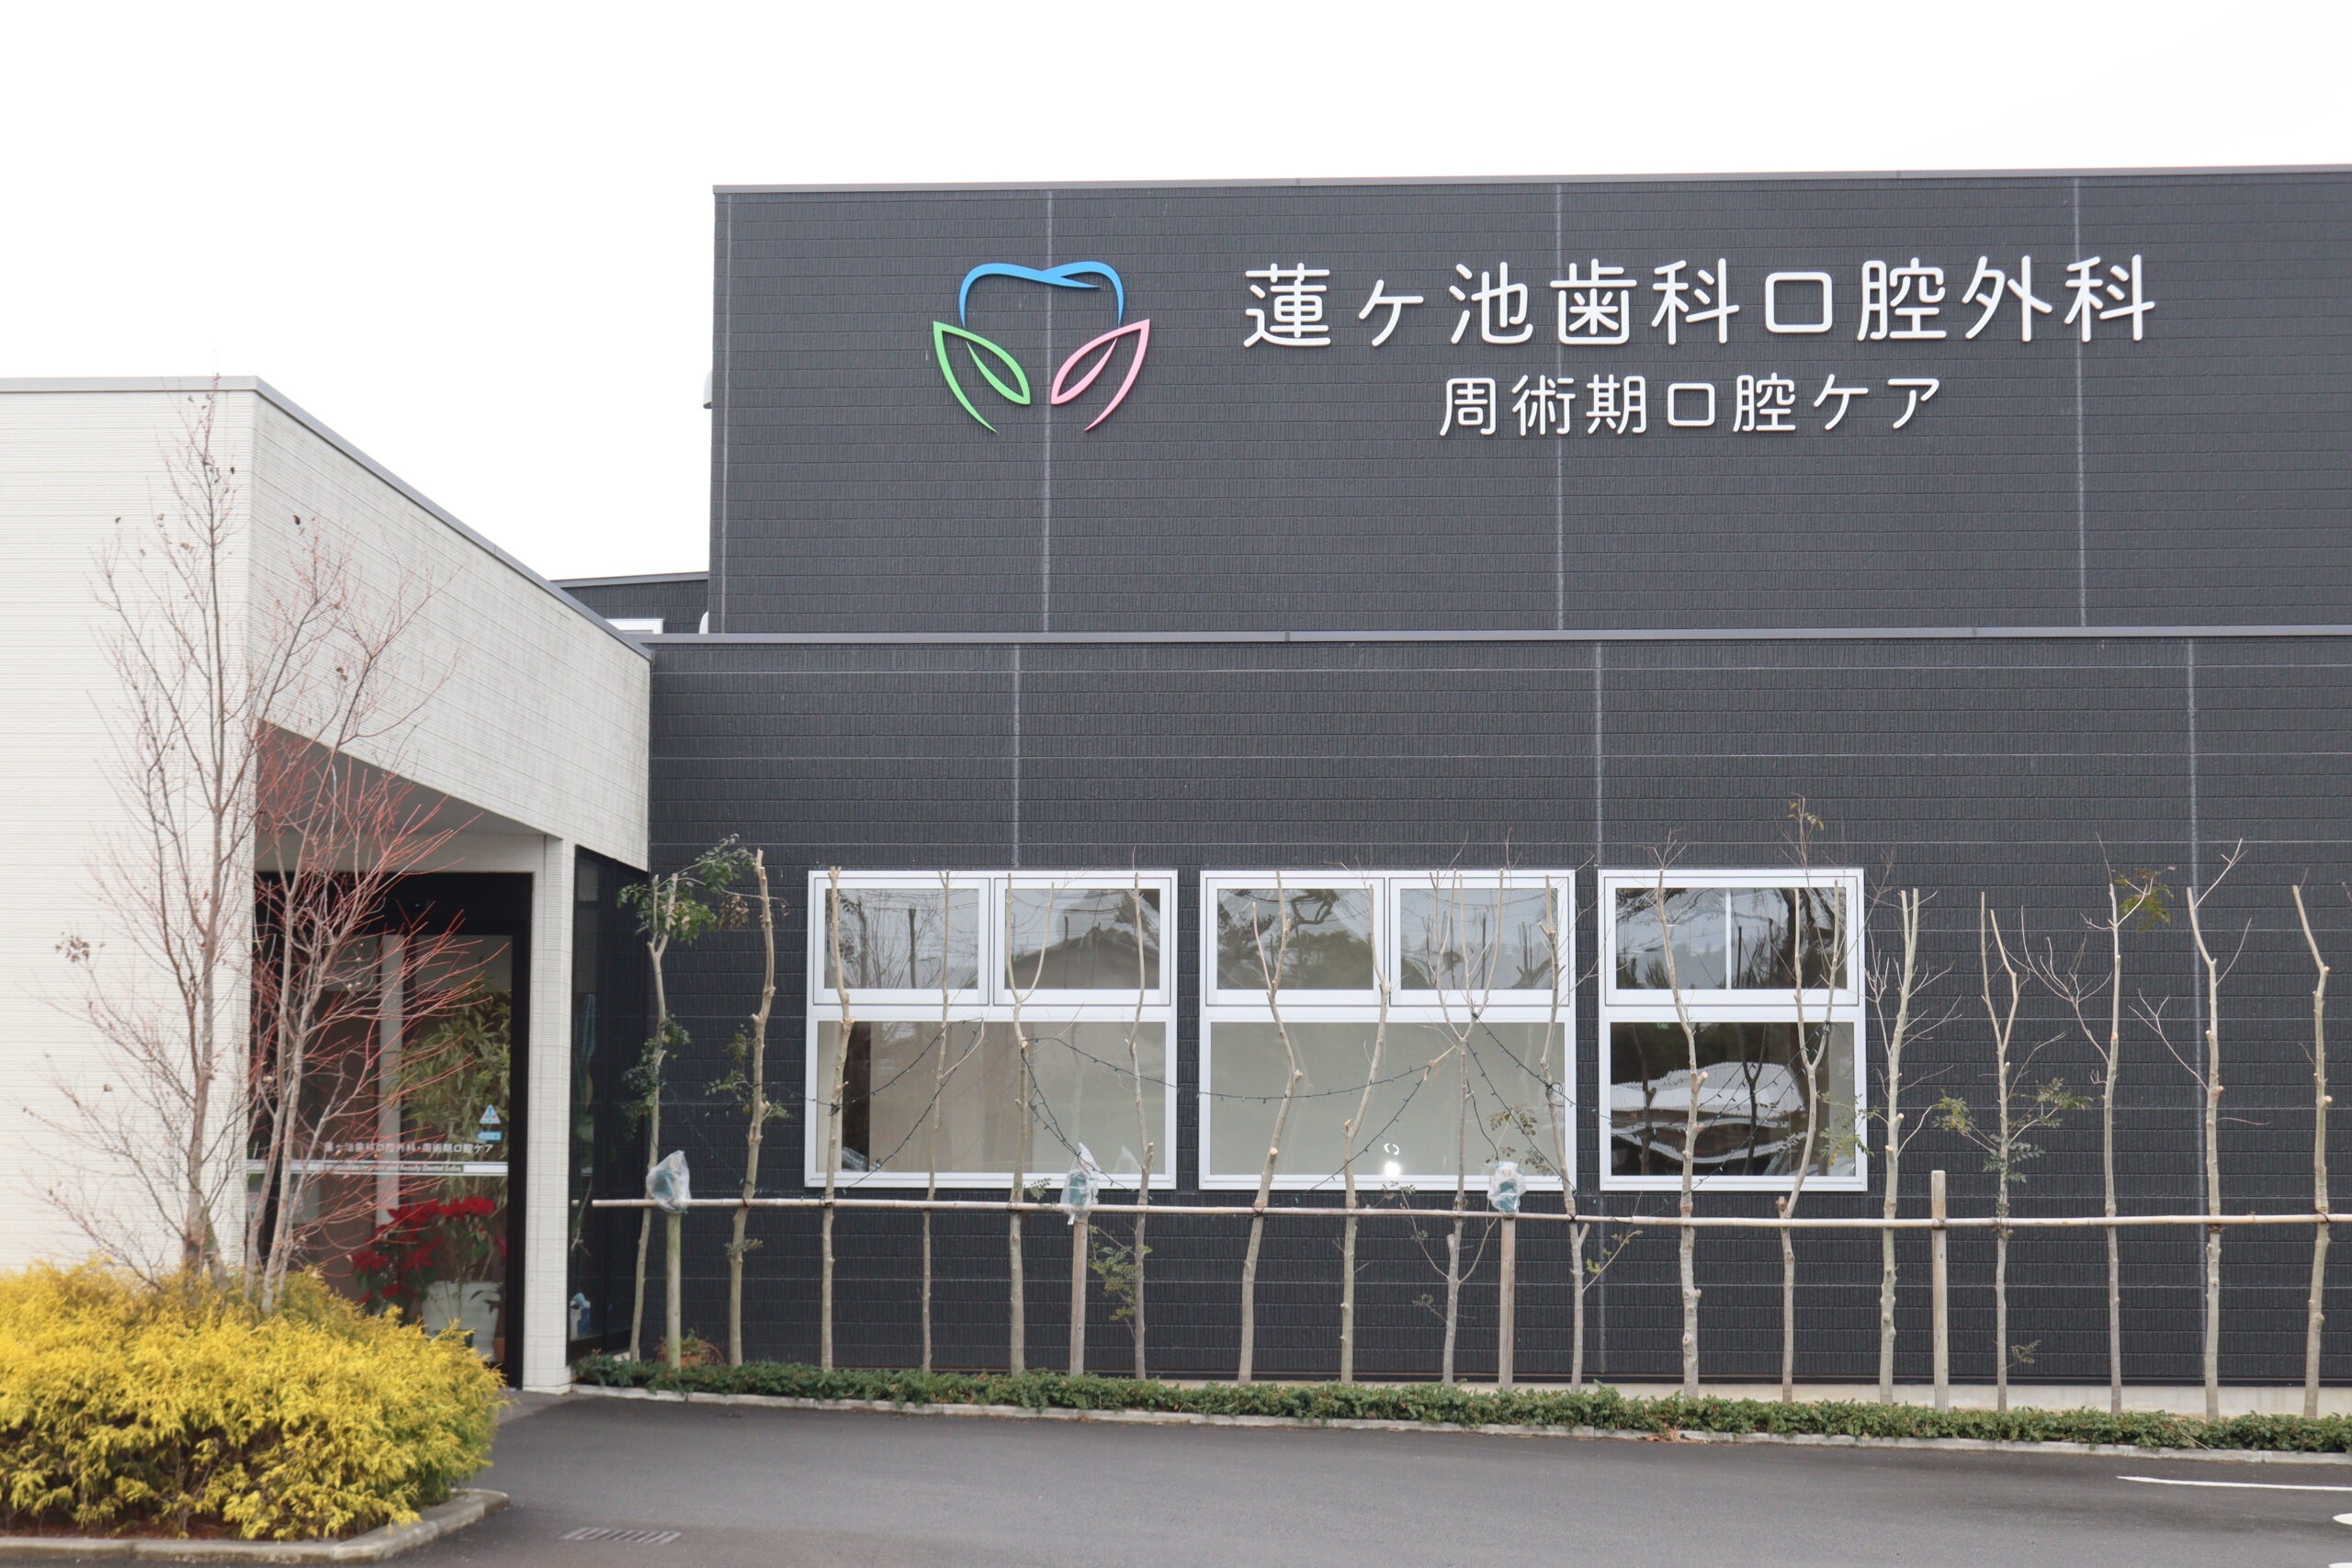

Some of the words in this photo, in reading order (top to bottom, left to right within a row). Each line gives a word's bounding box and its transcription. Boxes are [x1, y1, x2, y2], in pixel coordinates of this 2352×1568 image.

[1439, 372, 1940, 436] 周術期口腔ケア
